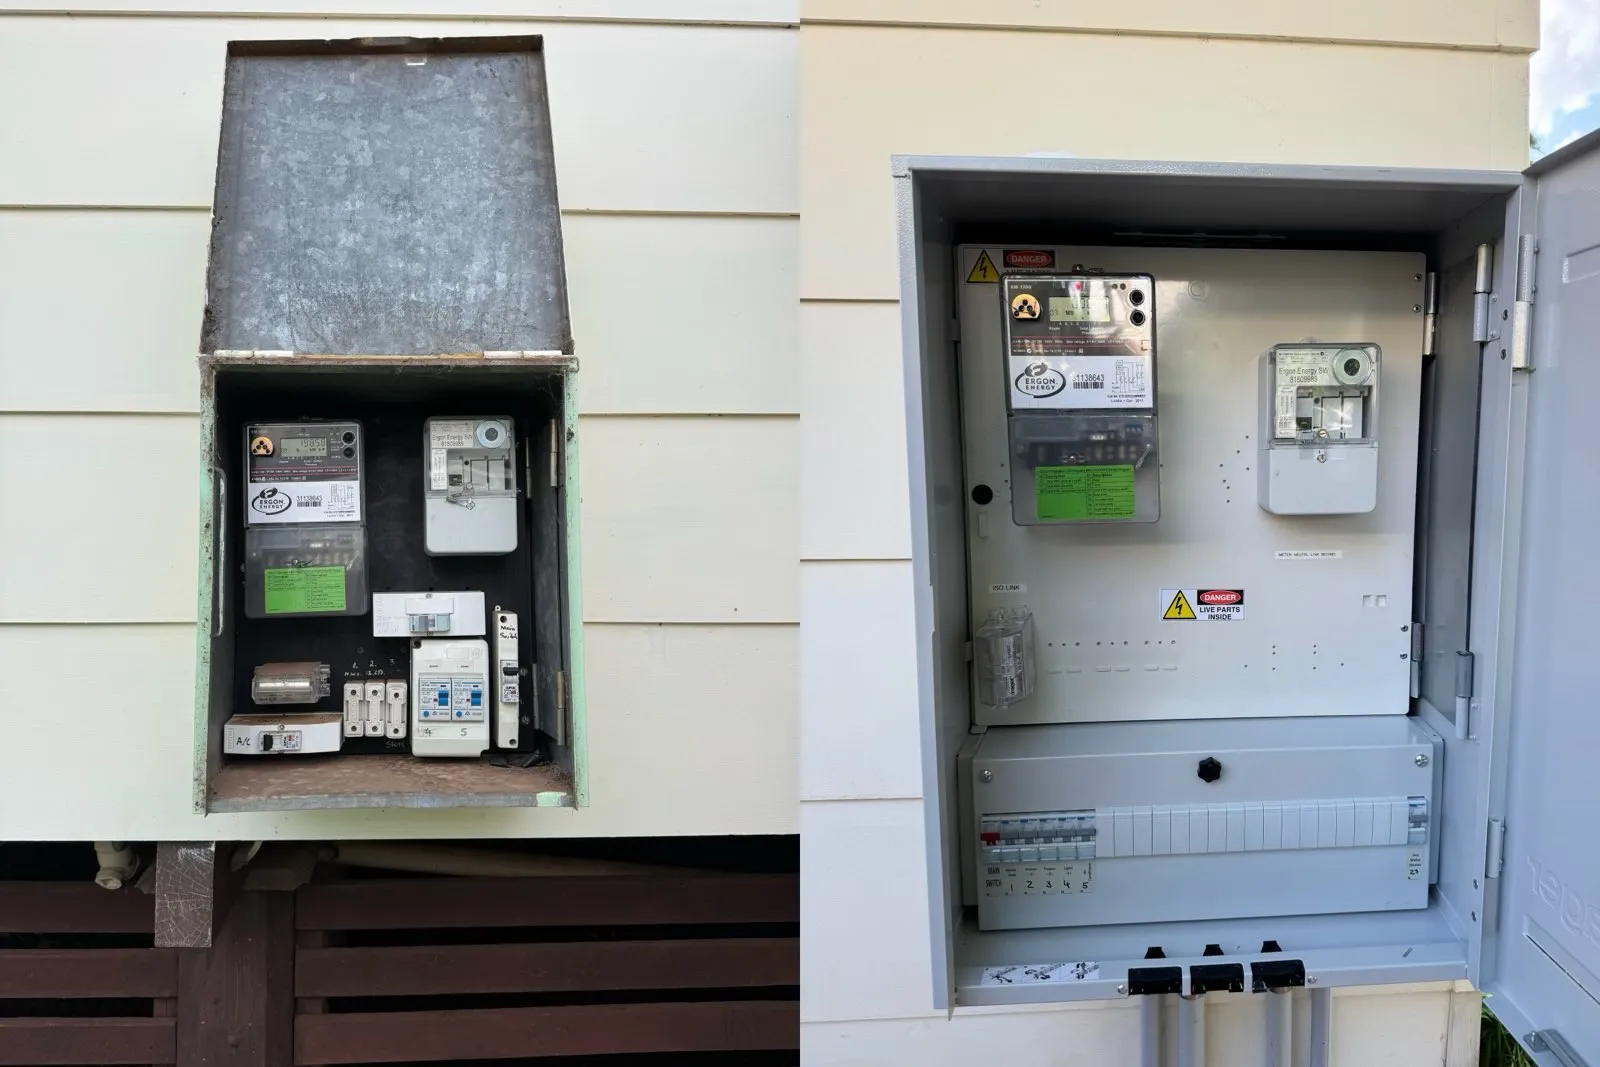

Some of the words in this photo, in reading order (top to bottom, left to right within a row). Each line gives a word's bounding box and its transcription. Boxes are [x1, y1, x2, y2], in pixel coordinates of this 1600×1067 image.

[1011, 254, 1047, 263] DANGER
[1279, 368, 1296, 376] Ergon
[1297, 367, 1317, 376] Energy
[1204, 594, 1236, 602] DANGER
[1207, 613, 1232, 621] INSIDE
[987, 867, 1000, 875] MAIN
[985, 879, 1002, 888] SWITCH
[1045, 880, 1053, 888] 3
[1063, 880, 1071, 889] 4
